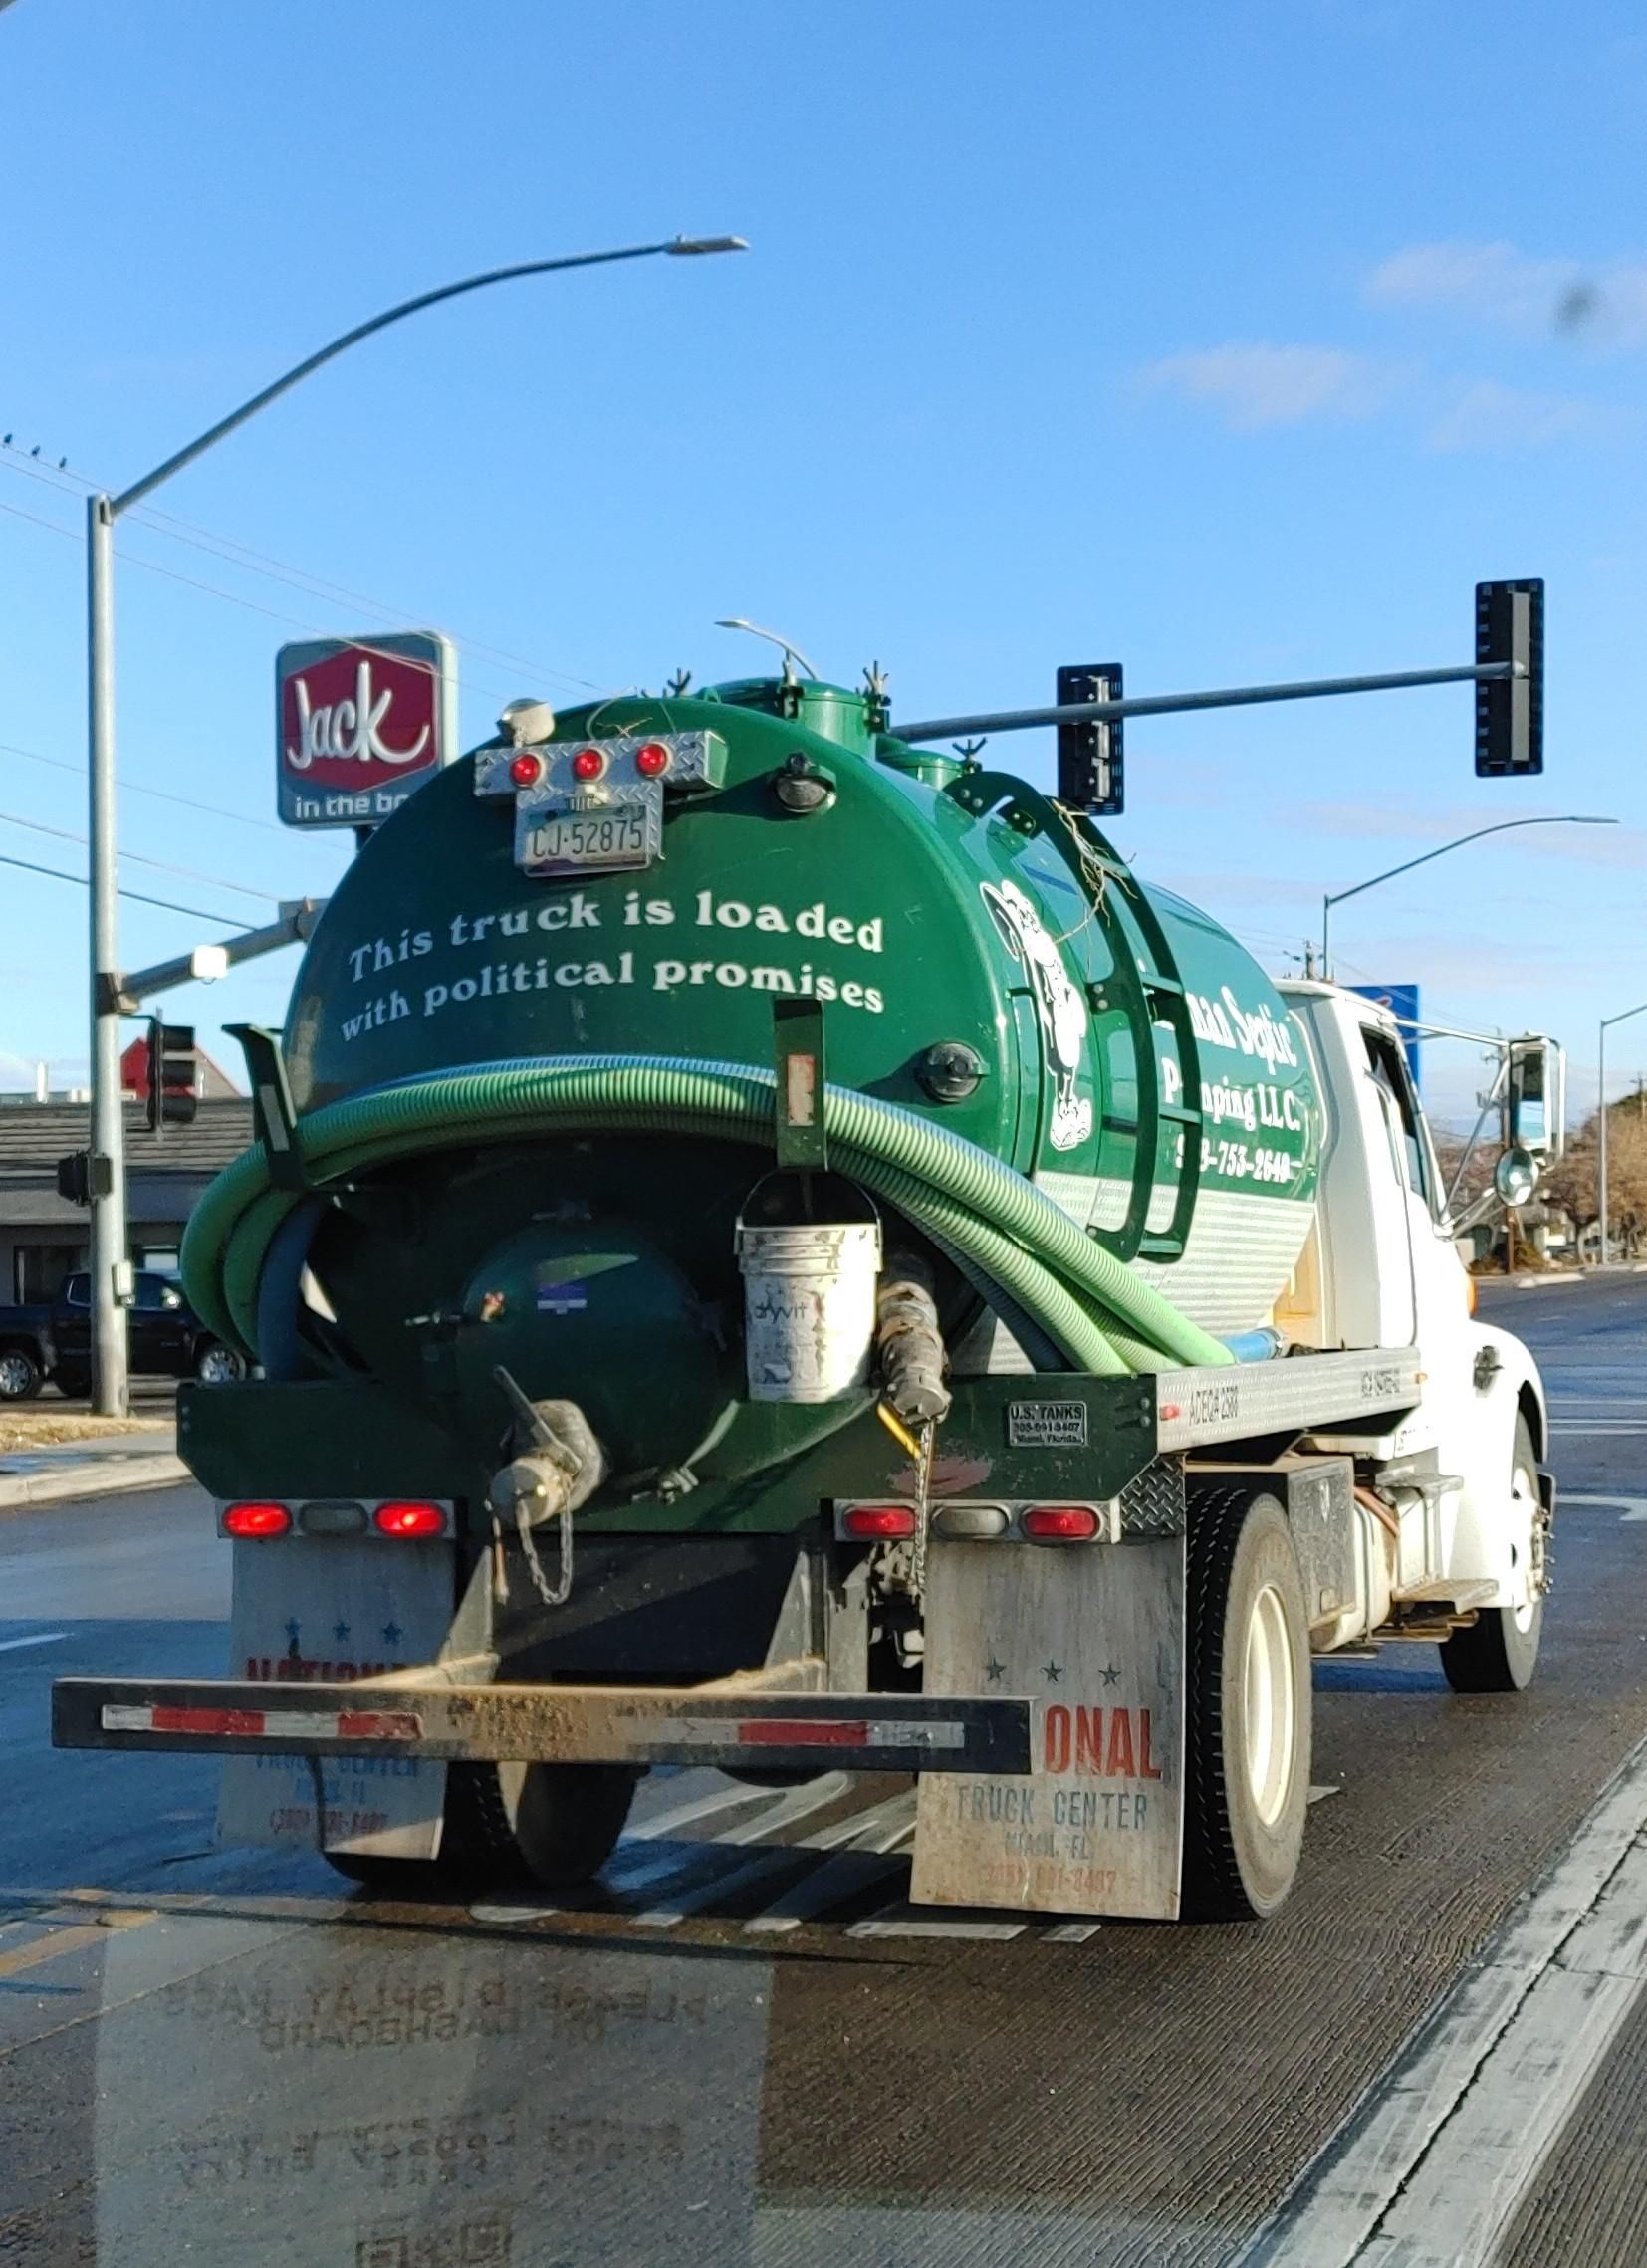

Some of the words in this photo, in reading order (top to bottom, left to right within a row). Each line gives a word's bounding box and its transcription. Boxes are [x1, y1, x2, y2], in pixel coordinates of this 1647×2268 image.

[286, 660, 431, 770] Jack
[295, 796, 320, 818] in
[326, 794, 371, 816] the
[349, 930, 433, 984] This
[449, 896, 601, 948] truck
[623, 891, 675, 927] is
[695, 891, 885, 955] loaded
[340, 991, 413, 1044] with
[423, 951, 635, 1018] political
[652, 960, 885, 1015] promises
[1040, 1405, 1082, 1420] TANKS
[1044, 1704, 1162, 1780] ONAL
[1053, 1790, 1148, 1831] CENTER
